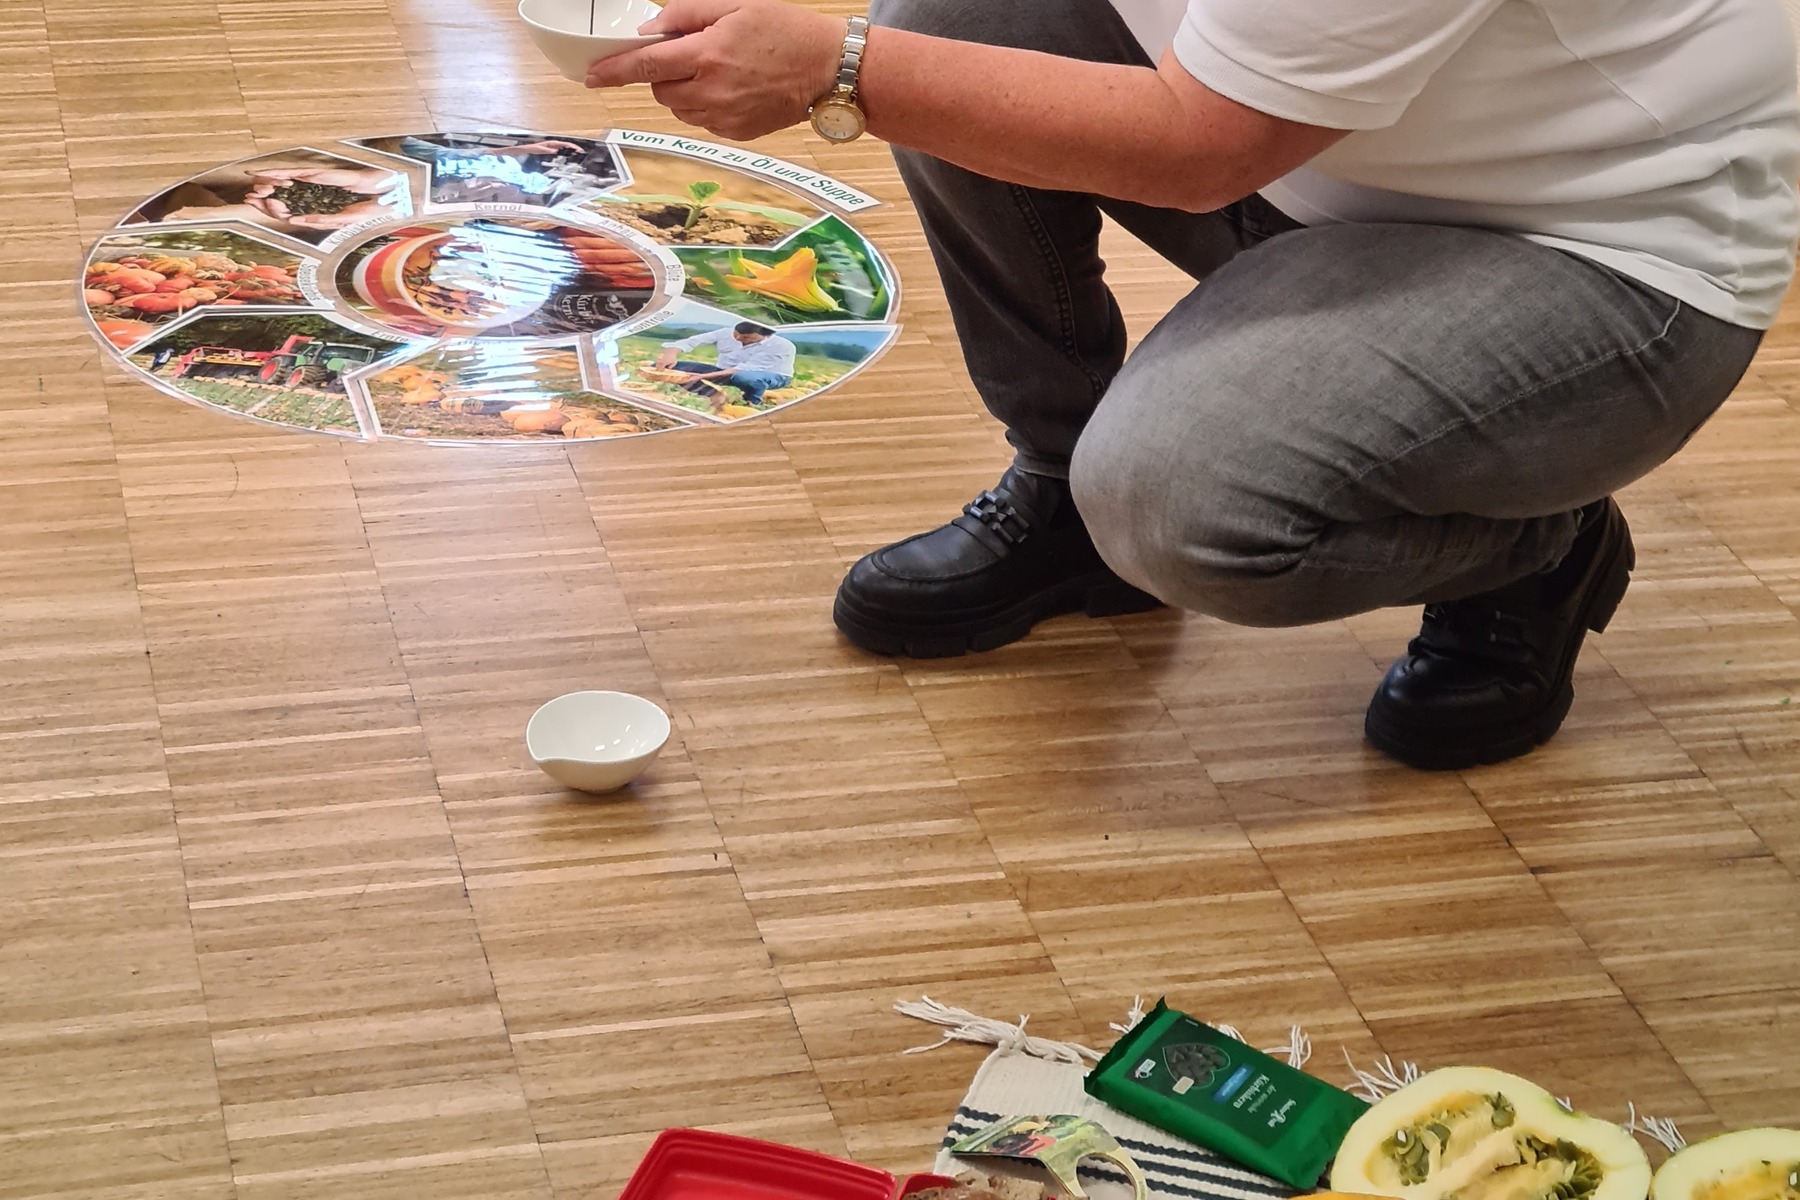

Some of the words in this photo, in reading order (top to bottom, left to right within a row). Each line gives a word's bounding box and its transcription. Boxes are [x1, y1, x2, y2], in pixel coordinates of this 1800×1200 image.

[622, 131, 665, 145] Vom
[671, 139, 719, 156] Kern
[722, 152, 748, 164] zu
[750, 157, 777, 170] Öl
[774, 167, 815, 183] und
[810, 179, 864, 205] Suppe
